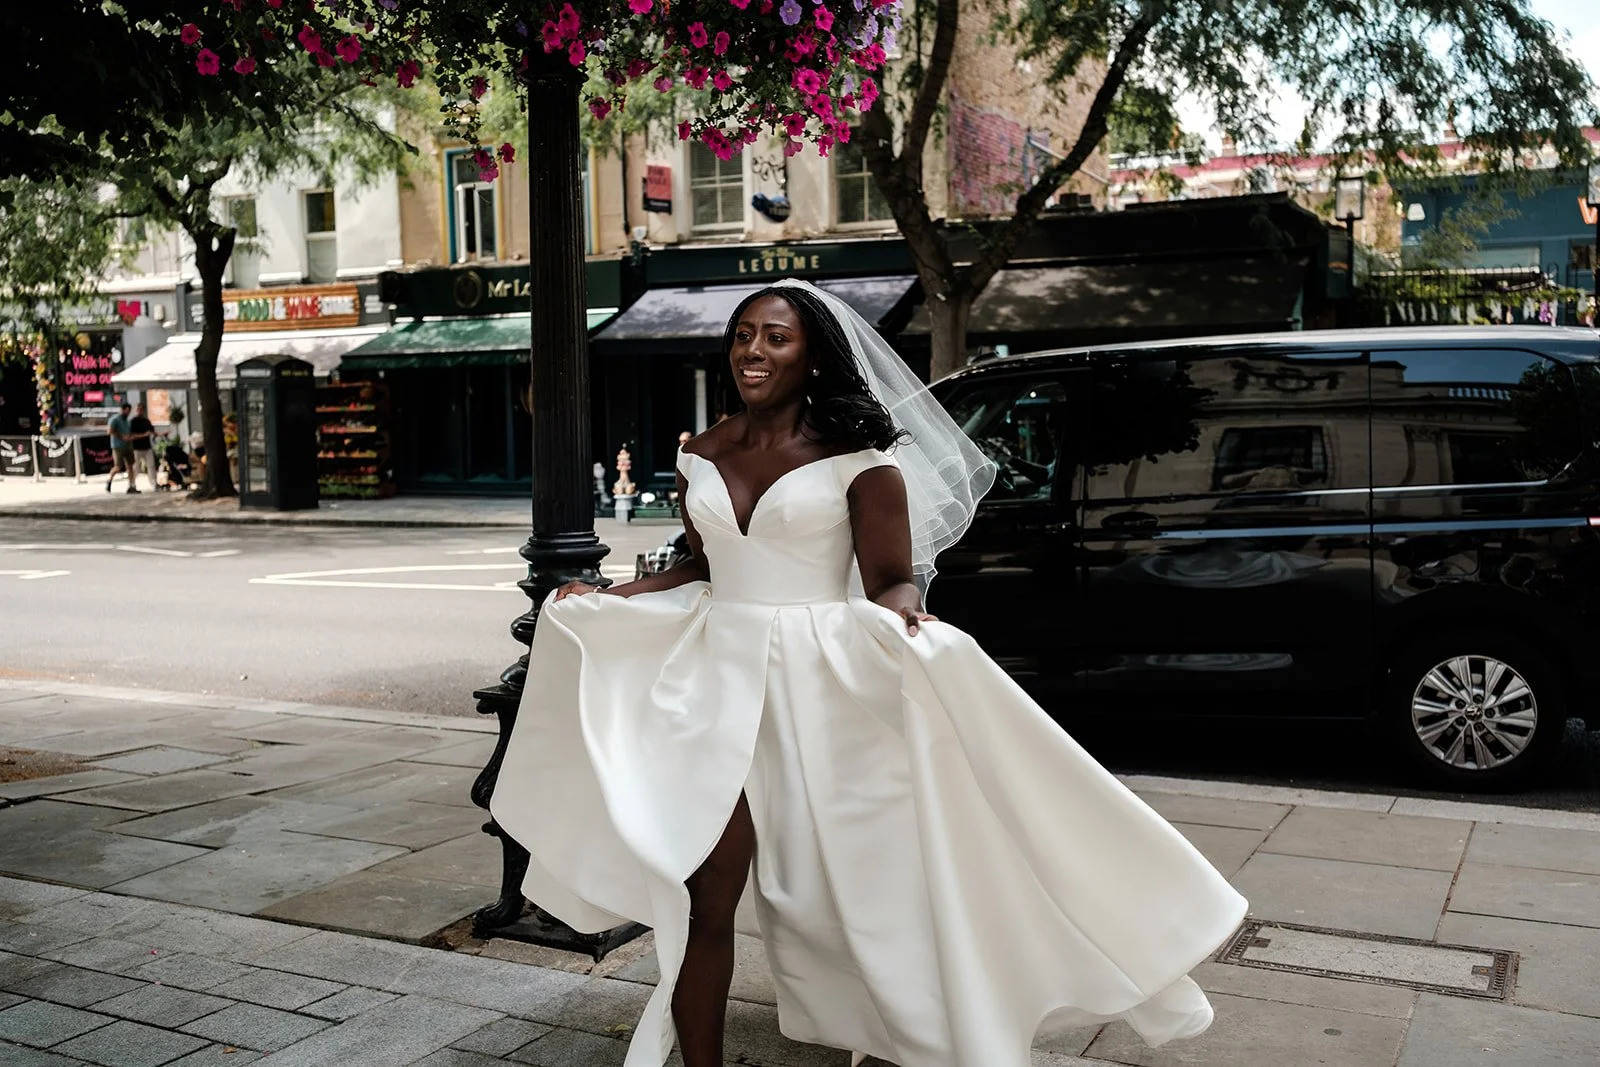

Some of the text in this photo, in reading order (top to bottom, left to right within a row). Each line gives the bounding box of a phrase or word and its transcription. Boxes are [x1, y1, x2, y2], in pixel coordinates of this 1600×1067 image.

[738, 255, 820, 273] LEGUME
[72, 354, 97, 369] Walk
[65, 371, 97, 385] Dance
